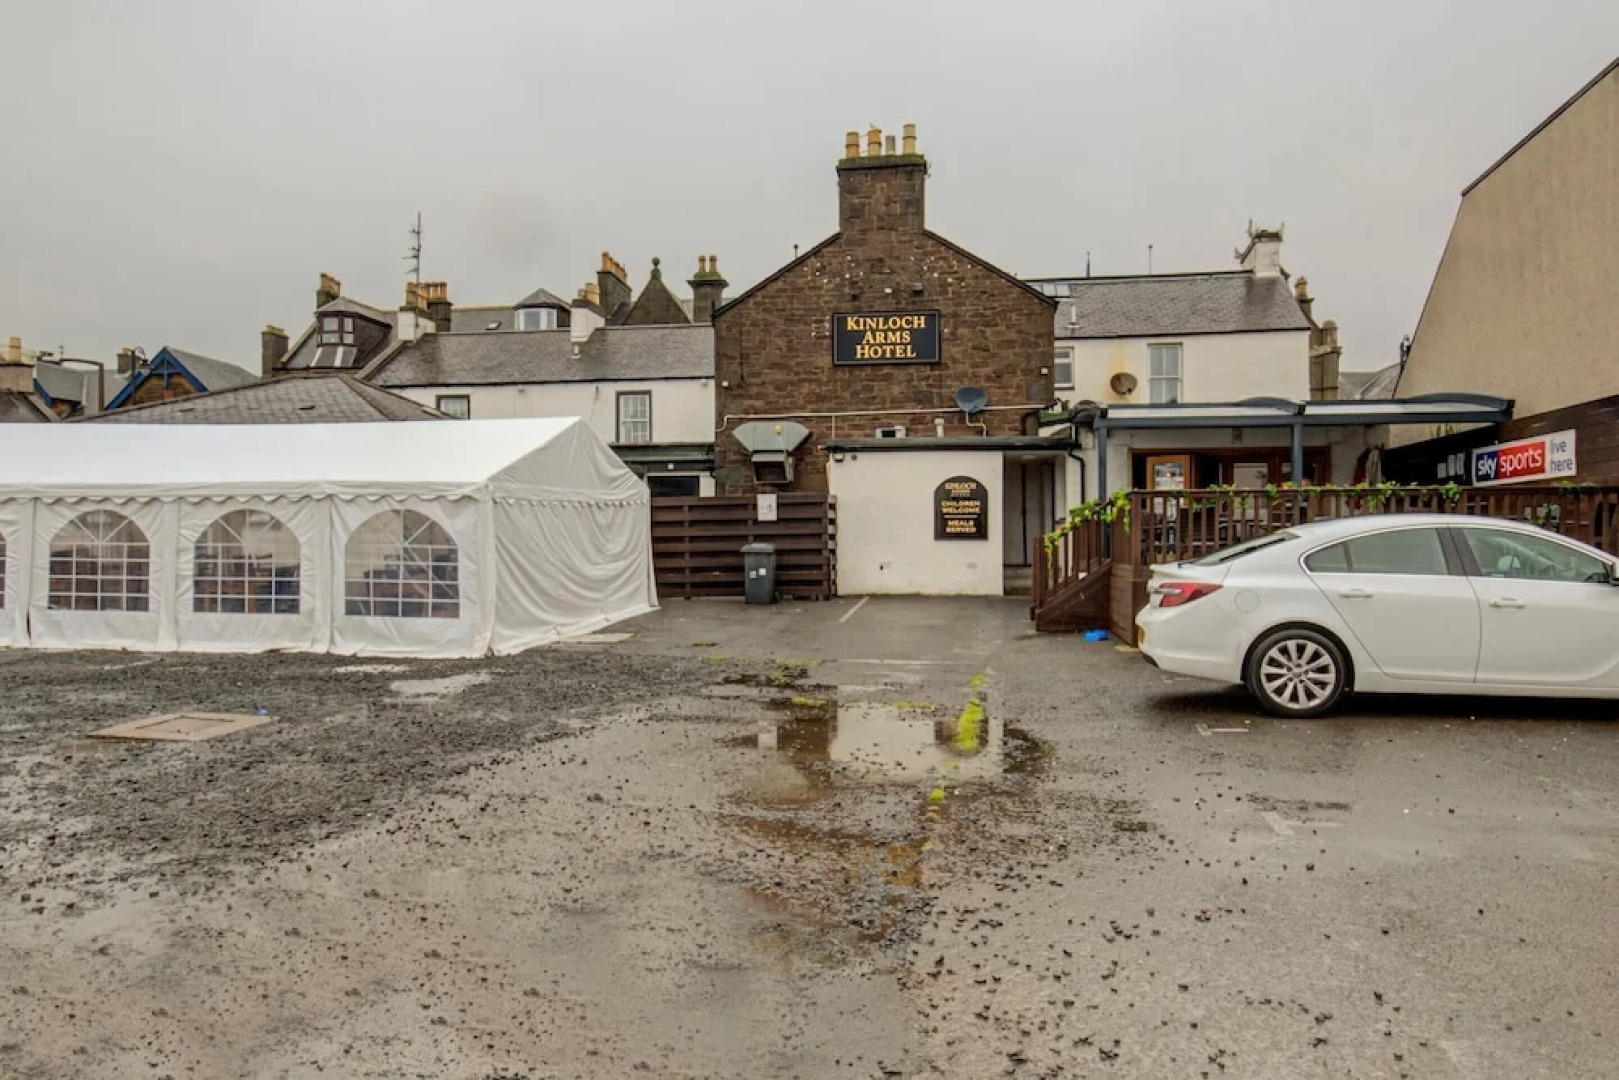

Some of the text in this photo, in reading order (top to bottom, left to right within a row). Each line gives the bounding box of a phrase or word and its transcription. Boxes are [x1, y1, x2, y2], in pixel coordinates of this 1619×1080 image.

[846, 315, 926, 330] KINLOCH
[862, 330, 911, 343] ARMS
[856, 344, 916, 359] HOTEL
[1550, 439, 1567, 453] live
[1477, 447, 1542, 479] sky sports
[1550, 457, 1573, 472] here
